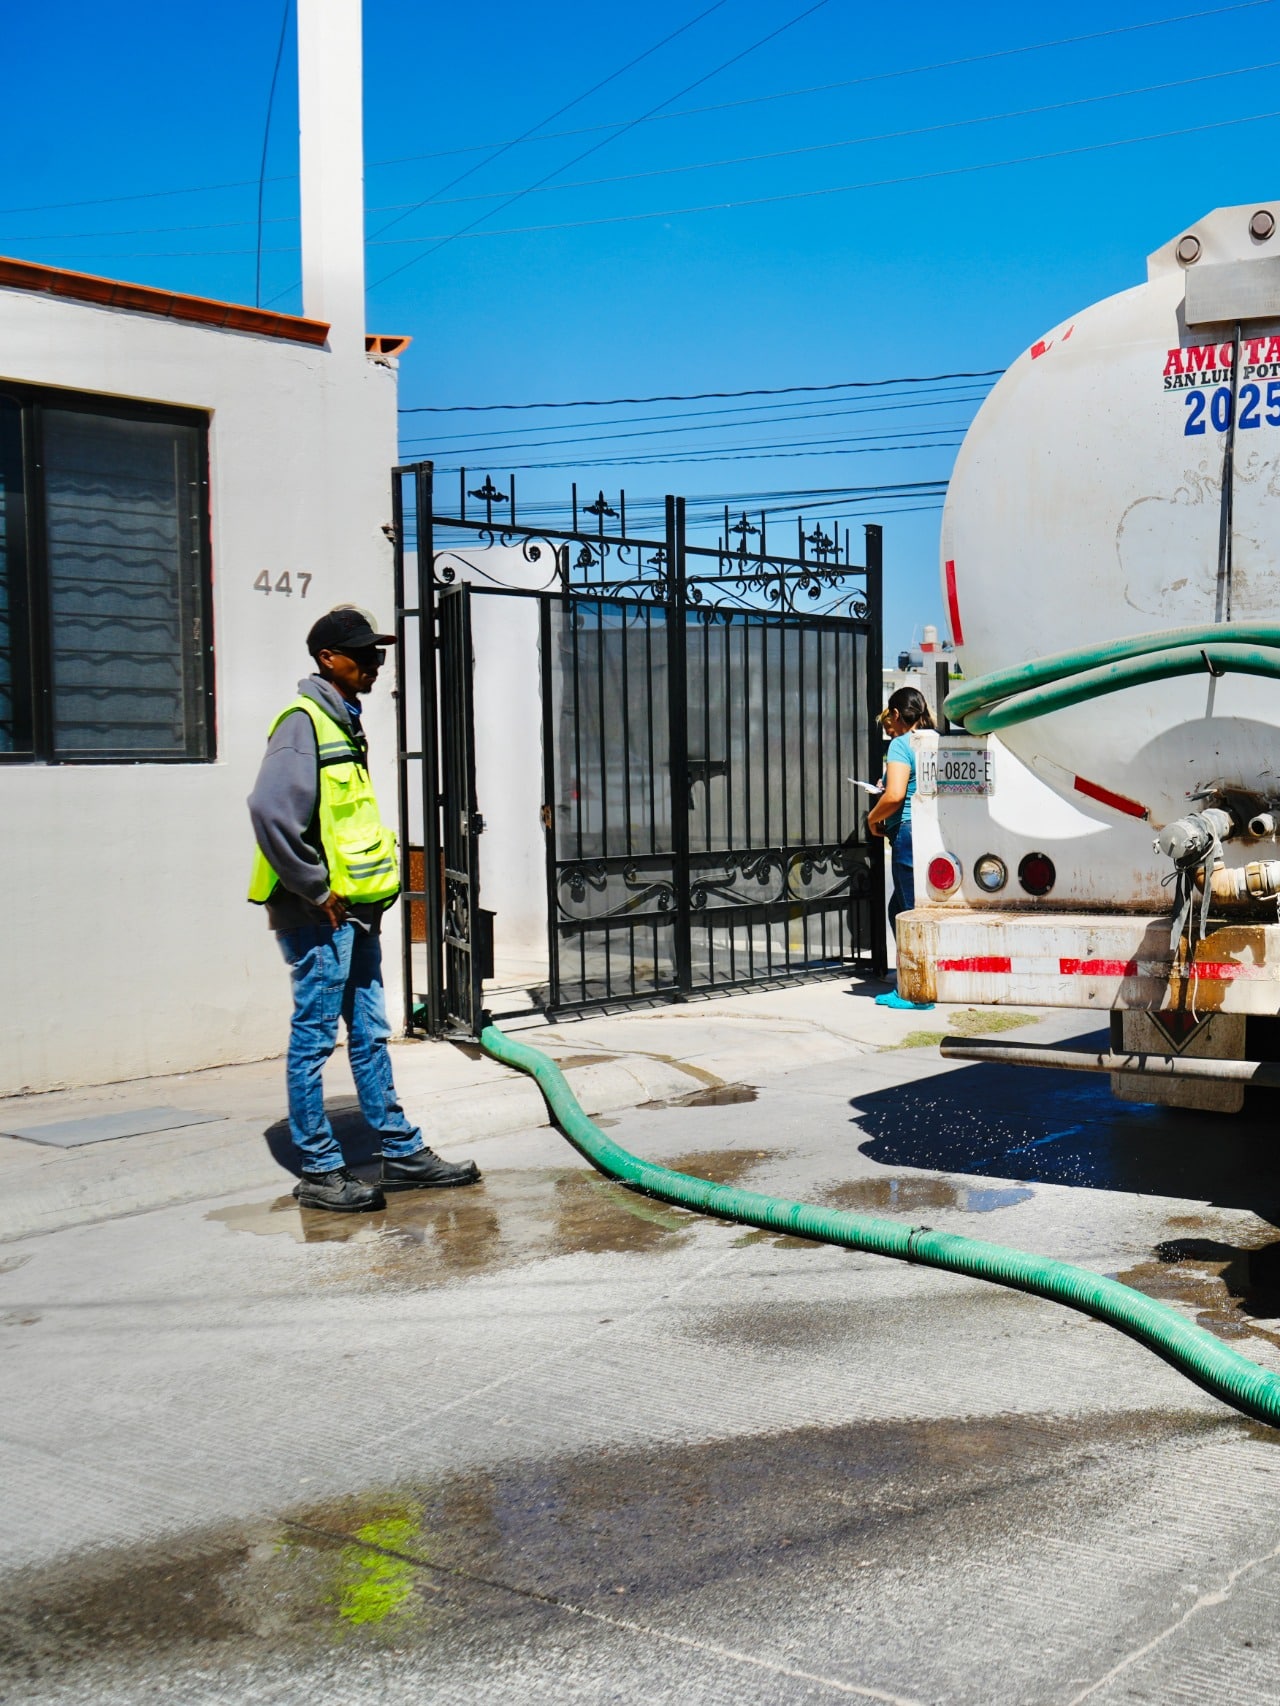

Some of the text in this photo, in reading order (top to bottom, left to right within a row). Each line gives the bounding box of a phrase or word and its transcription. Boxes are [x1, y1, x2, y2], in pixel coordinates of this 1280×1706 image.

[1164, 372, 1197, 389] SAN
[253, 569, 312, 599] 447
[922, 761, 992, 782] HA-0828-E
